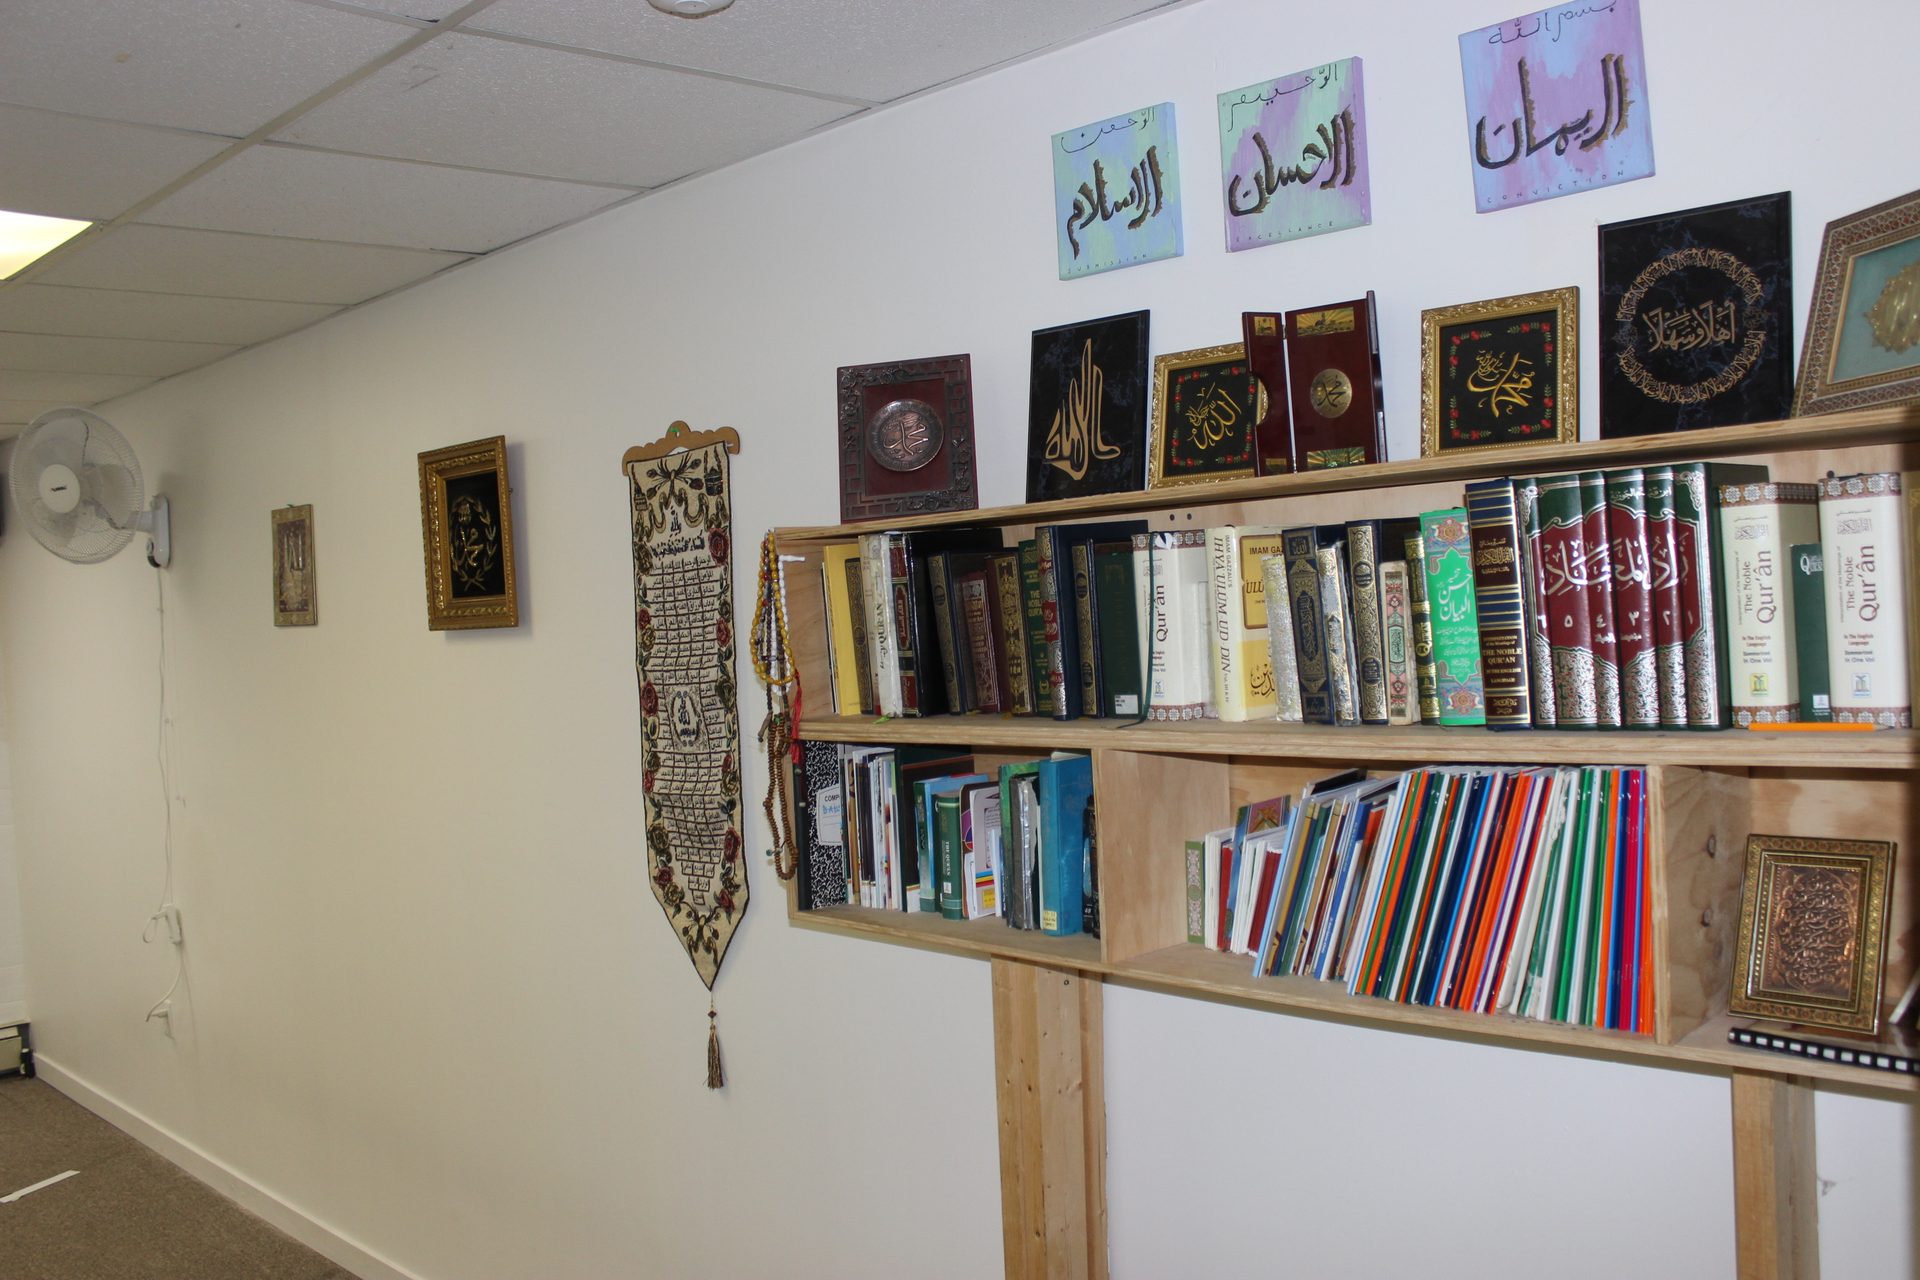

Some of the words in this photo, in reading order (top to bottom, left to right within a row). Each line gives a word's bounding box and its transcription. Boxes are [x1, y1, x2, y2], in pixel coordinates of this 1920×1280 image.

[1486, 169, 1624, 204] CONVICTION
[1249, 546, 1269, 555] IMAM
[1742, 561, 1752, 591] Noble
[1844, 556, 1854, 587] Noble
[1744, 594, 1753, 613] The
[1846, 591, 1855, 610] The
[1496, 648, 1523, 656] NOBLE
